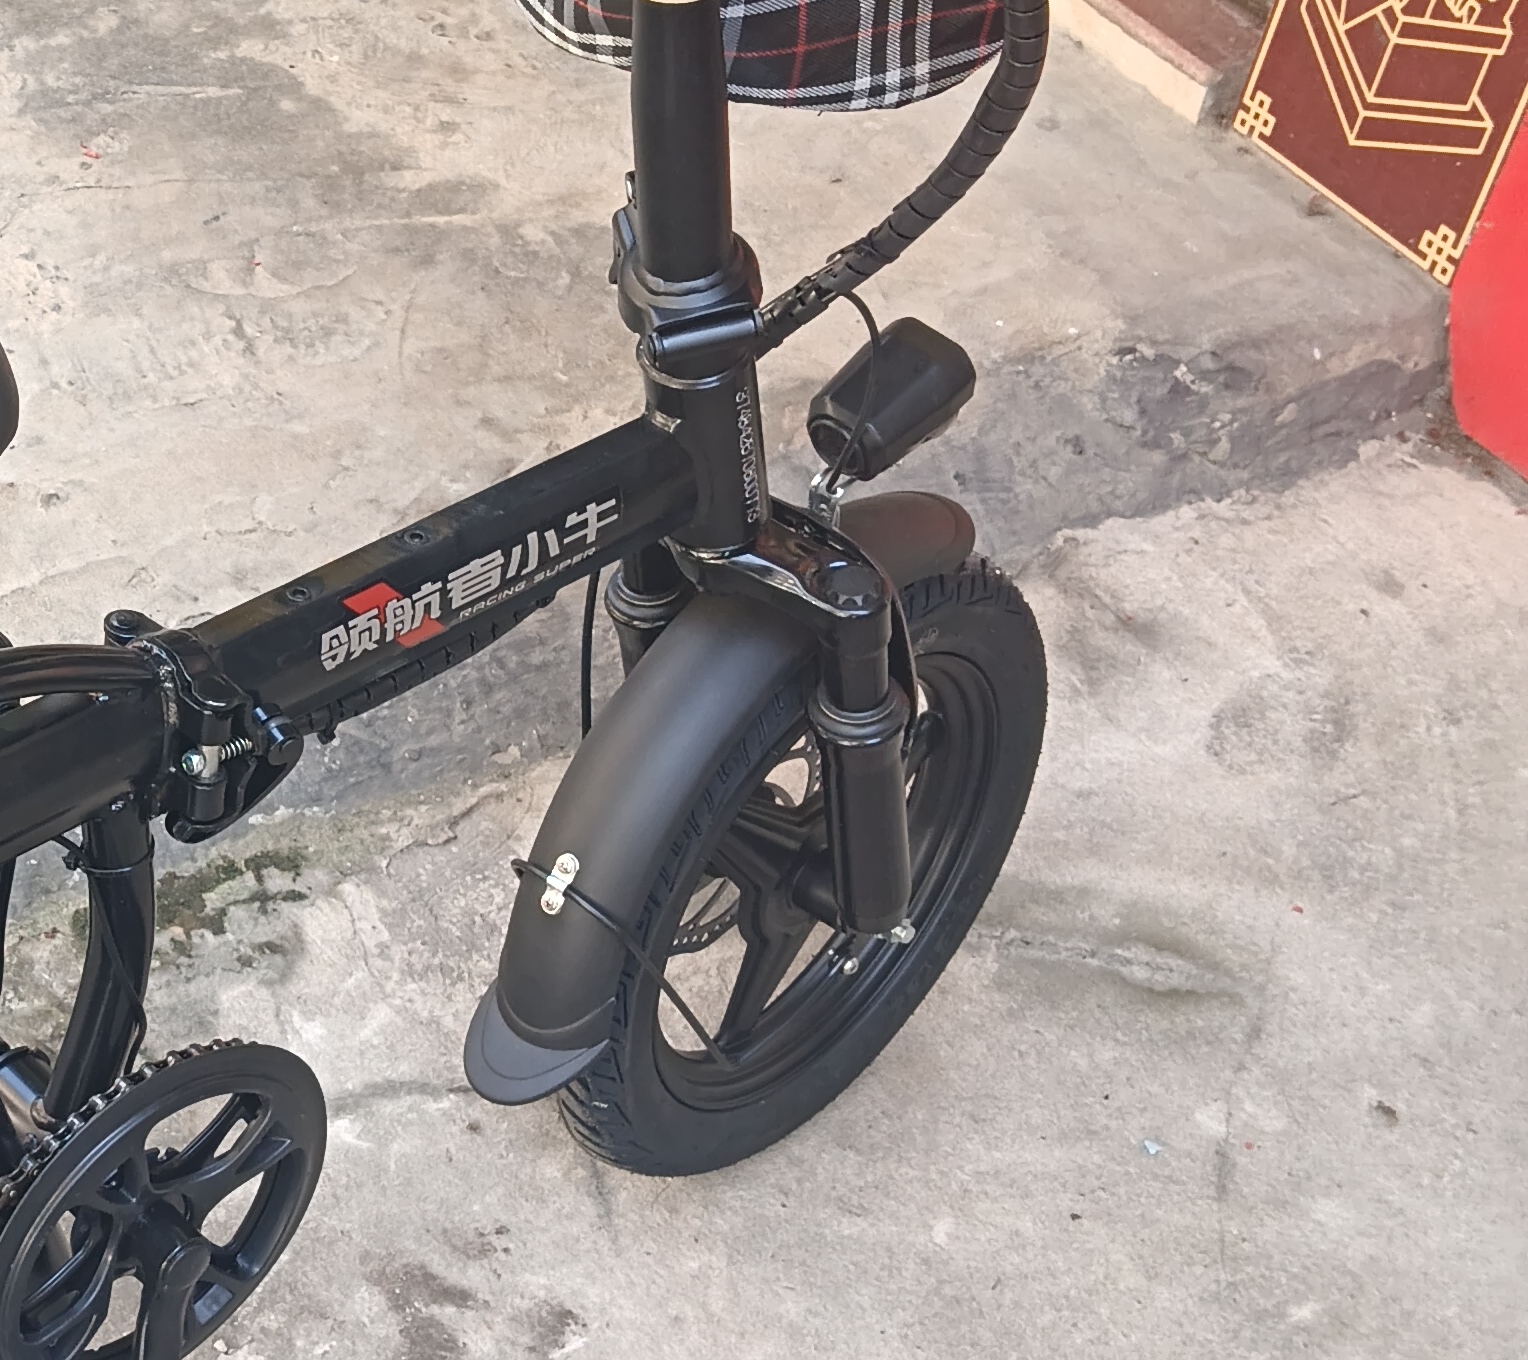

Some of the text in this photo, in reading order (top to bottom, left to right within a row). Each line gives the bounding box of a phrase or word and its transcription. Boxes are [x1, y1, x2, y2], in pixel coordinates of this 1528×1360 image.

[320, 498, 619, 672] 领航者小牛
[458, 547, 596, 620] RACING SUPER
